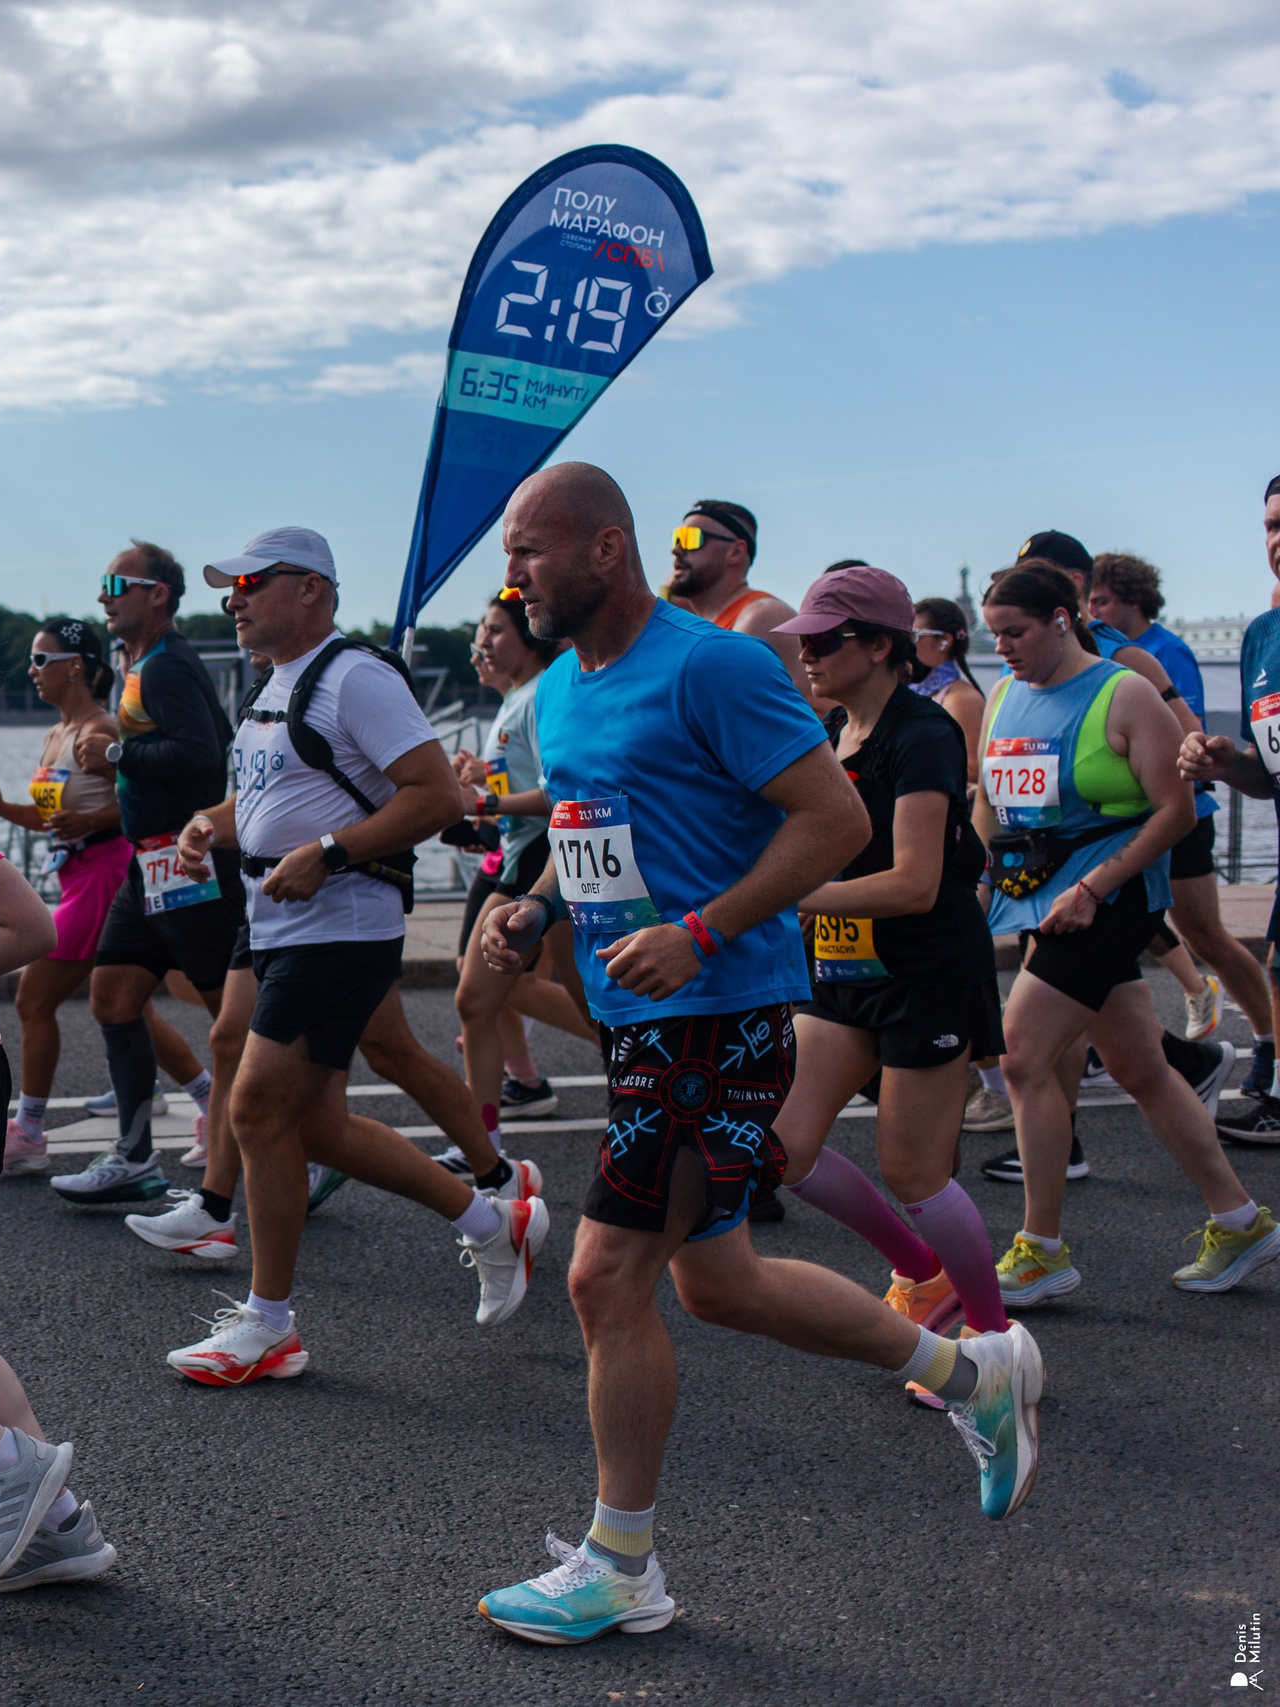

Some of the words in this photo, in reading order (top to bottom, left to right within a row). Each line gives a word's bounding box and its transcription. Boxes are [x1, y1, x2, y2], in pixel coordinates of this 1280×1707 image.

[554, 187, 617, 215] ПОЛУ
[549, 209, 665, 248] МАРАФОН
[495, 260, 633, 354] 2:19
[459, 367, 520, 404] 6:35
[522, 394, 547, 411] КМ
[991, 768, 1046, 795] 7128
[578, 809, 593, 822] 21,1
[595, 806, 612, 819] КМ
[558, 838, 622, 879] 1716
[581, 883, 600, 894] ОЛЕГ
[687, 916, 702, 934] 1716
